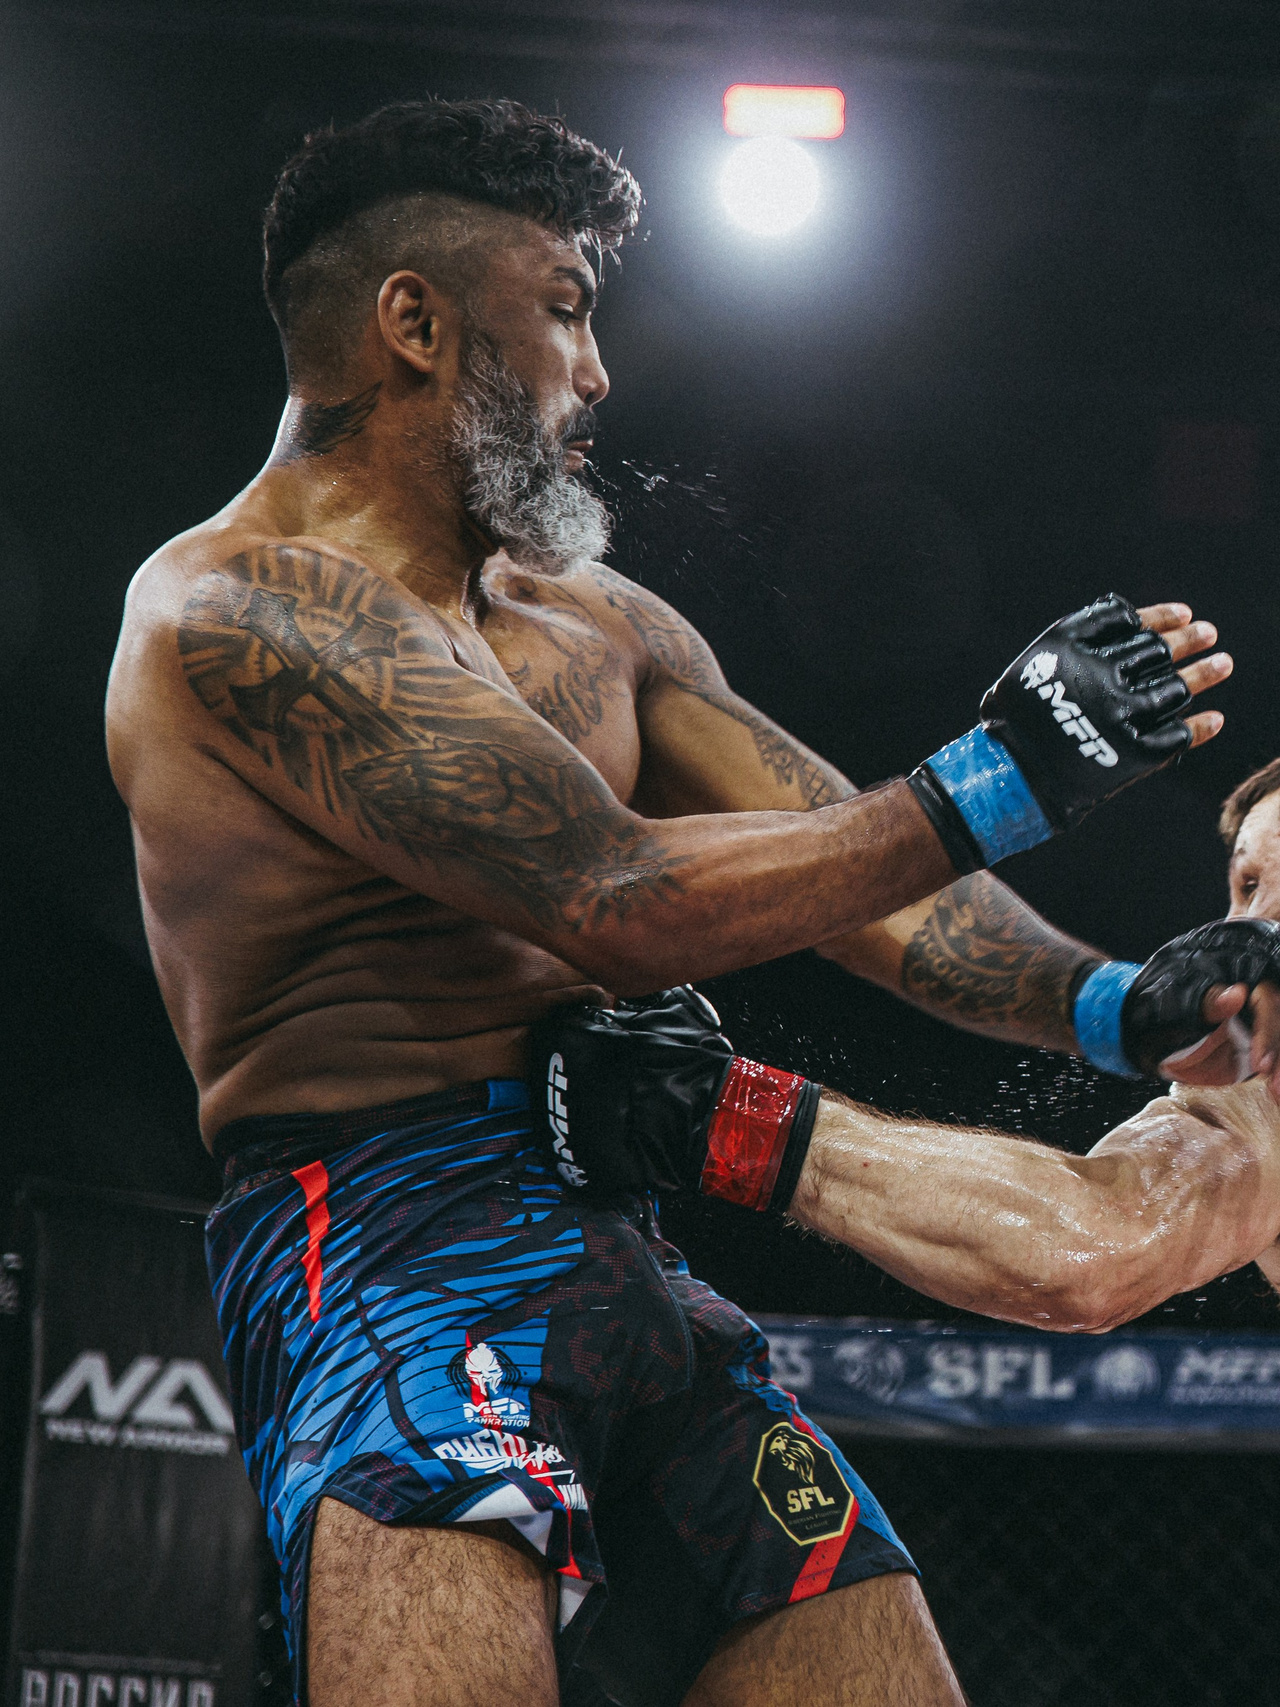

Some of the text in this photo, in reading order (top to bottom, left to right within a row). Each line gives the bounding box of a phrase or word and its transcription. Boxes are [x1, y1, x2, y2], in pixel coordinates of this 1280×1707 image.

[1037, 680, 1119, 768] MFP
[547, 1052, 574, 1162] MFP
[928, 1342, 1076, 1399] SFL
[787, 1485, 836, 1514] SFL
